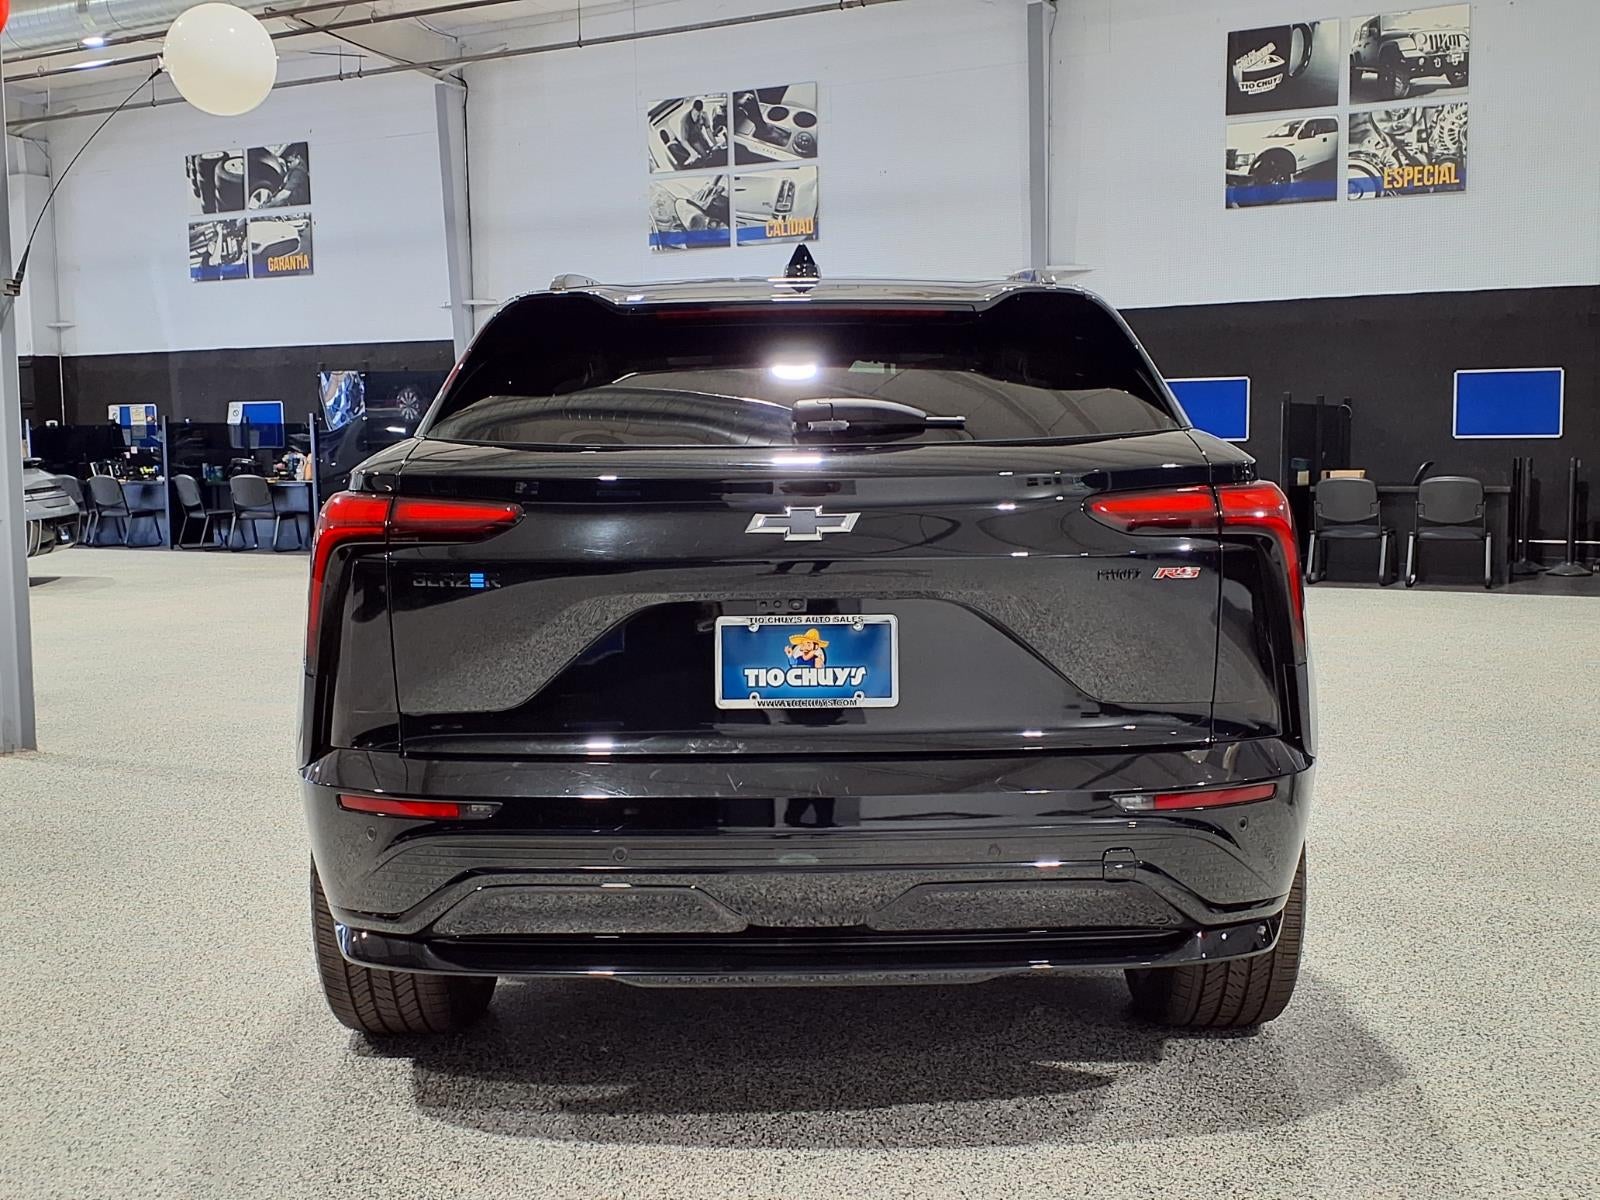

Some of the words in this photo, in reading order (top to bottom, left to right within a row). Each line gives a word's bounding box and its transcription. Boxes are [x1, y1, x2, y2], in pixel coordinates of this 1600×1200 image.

[1383, 163, 1460, 189] ESPECIAL
[766, 217, 814, 238] CALIDAD
[1152, 566, 1201, 579] RS
[748, 616, 765, 624] TIO
[767, 616, 803, 624] CHUY'S
[805, 616, 831, 624] AUTO
[832, 615, 864, 623] SALES
